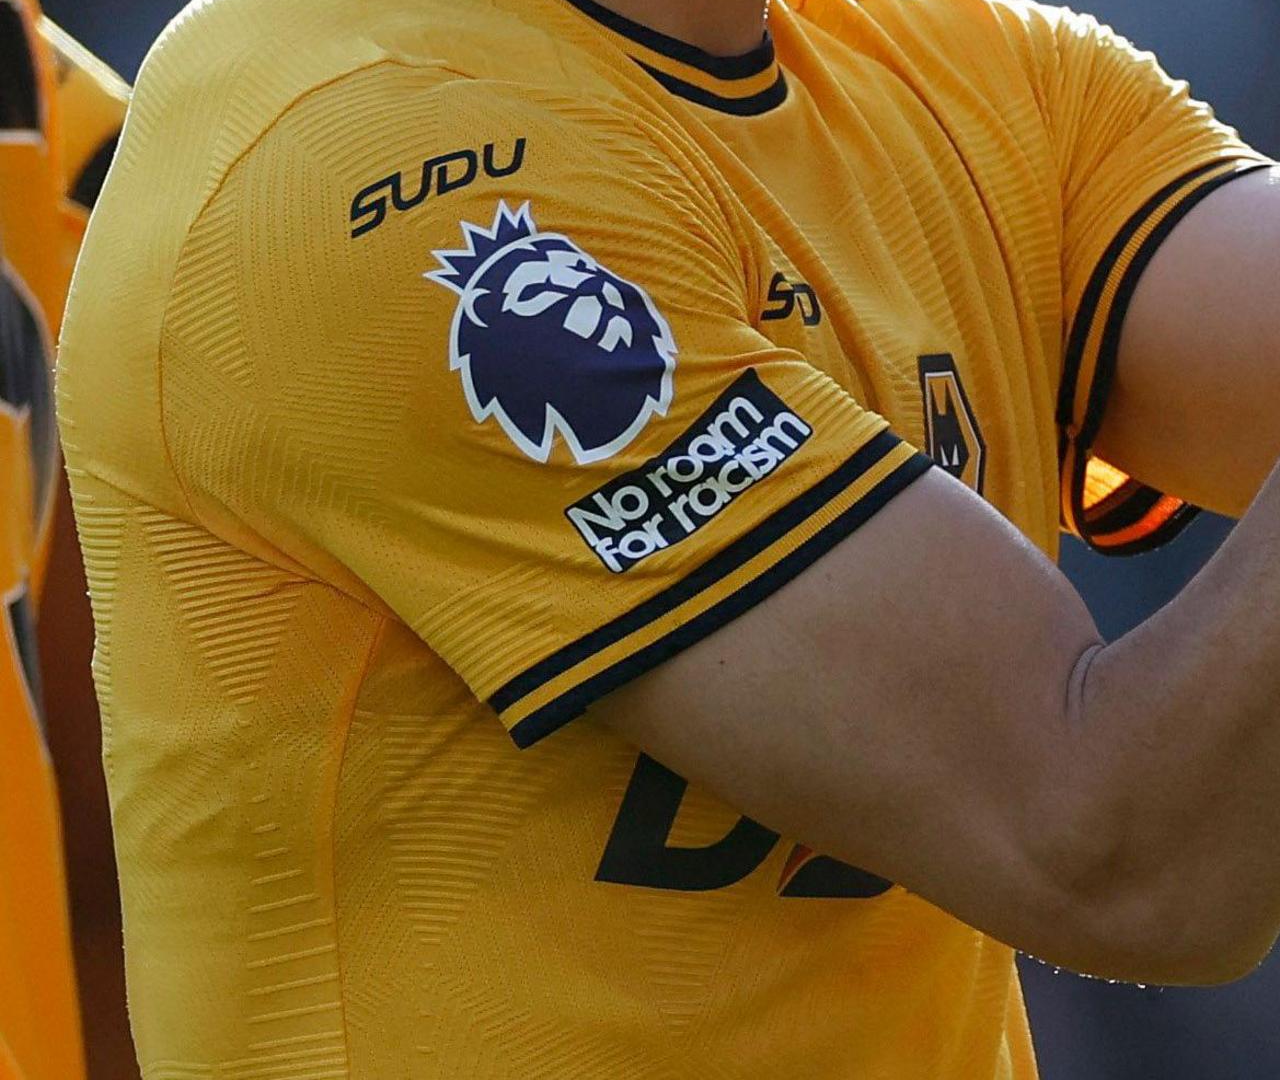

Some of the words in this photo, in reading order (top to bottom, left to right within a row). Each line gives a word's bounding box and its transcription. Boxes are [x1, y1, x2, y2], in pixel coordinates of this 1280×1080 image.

[350, 137, 527, 239] SUDU
[567, 485, 649, 547] No
[646, 396, 764, 498] room
[596, 513, 669, 573] for
[667, 411, 812, 533] racism
